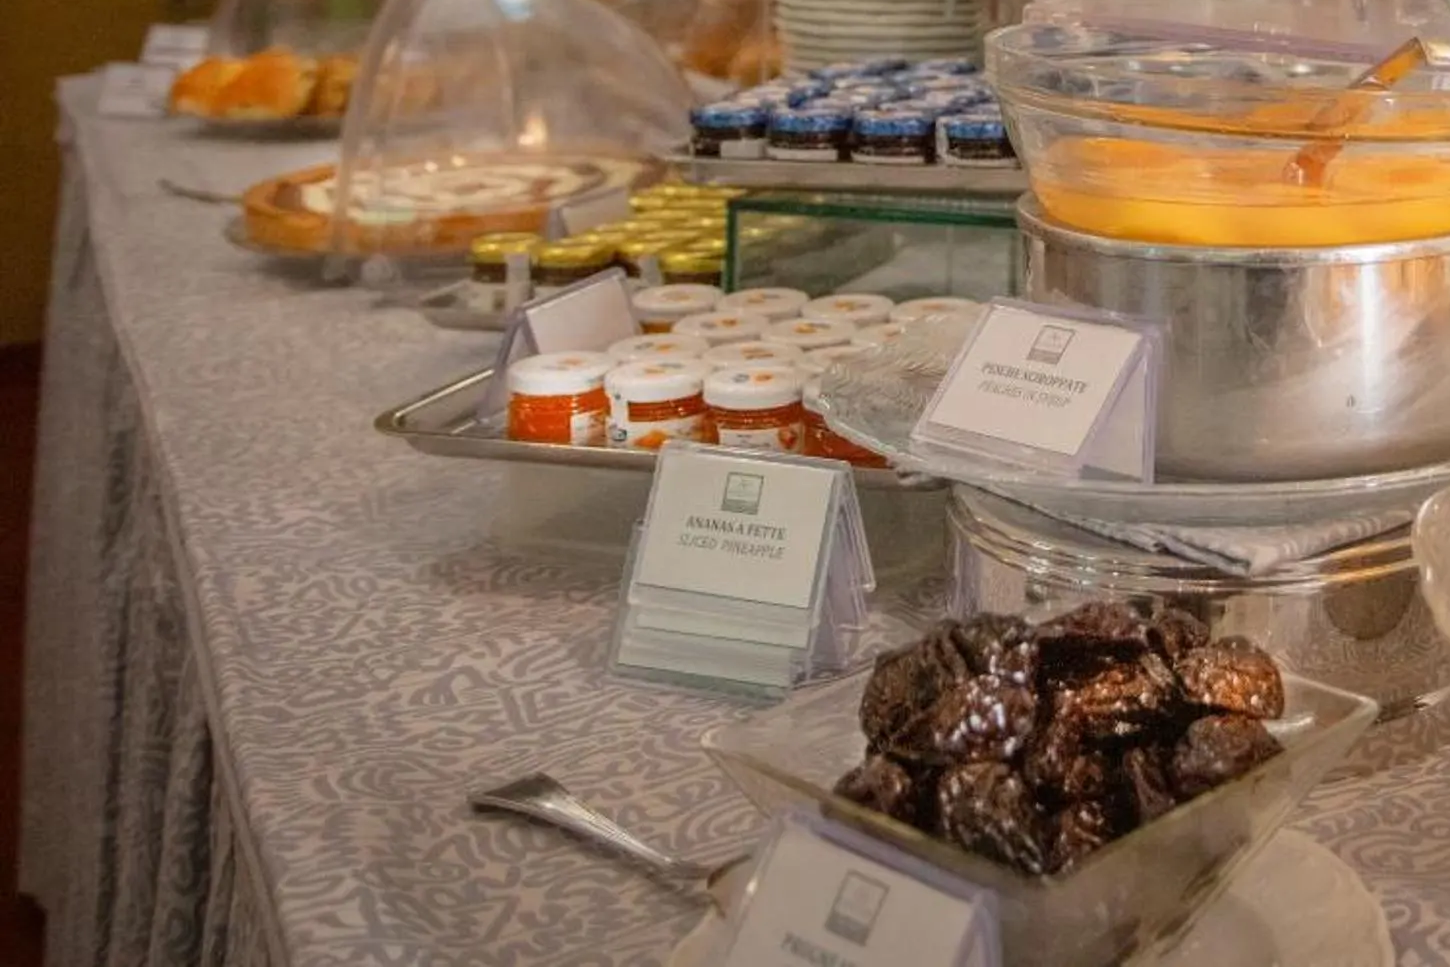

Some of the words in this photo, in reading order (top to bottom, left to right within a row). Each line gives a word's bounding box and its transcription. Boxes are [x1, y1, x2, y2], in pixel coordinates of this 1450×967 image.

[686, 516, 734, 533] ANANAS
[735, 523, 744, 535] A
[747, 524, 787, 540] FETTE
[678, 533, 717, 549] SLICED
[720, 539, 786, 559] PINEAPPLE
